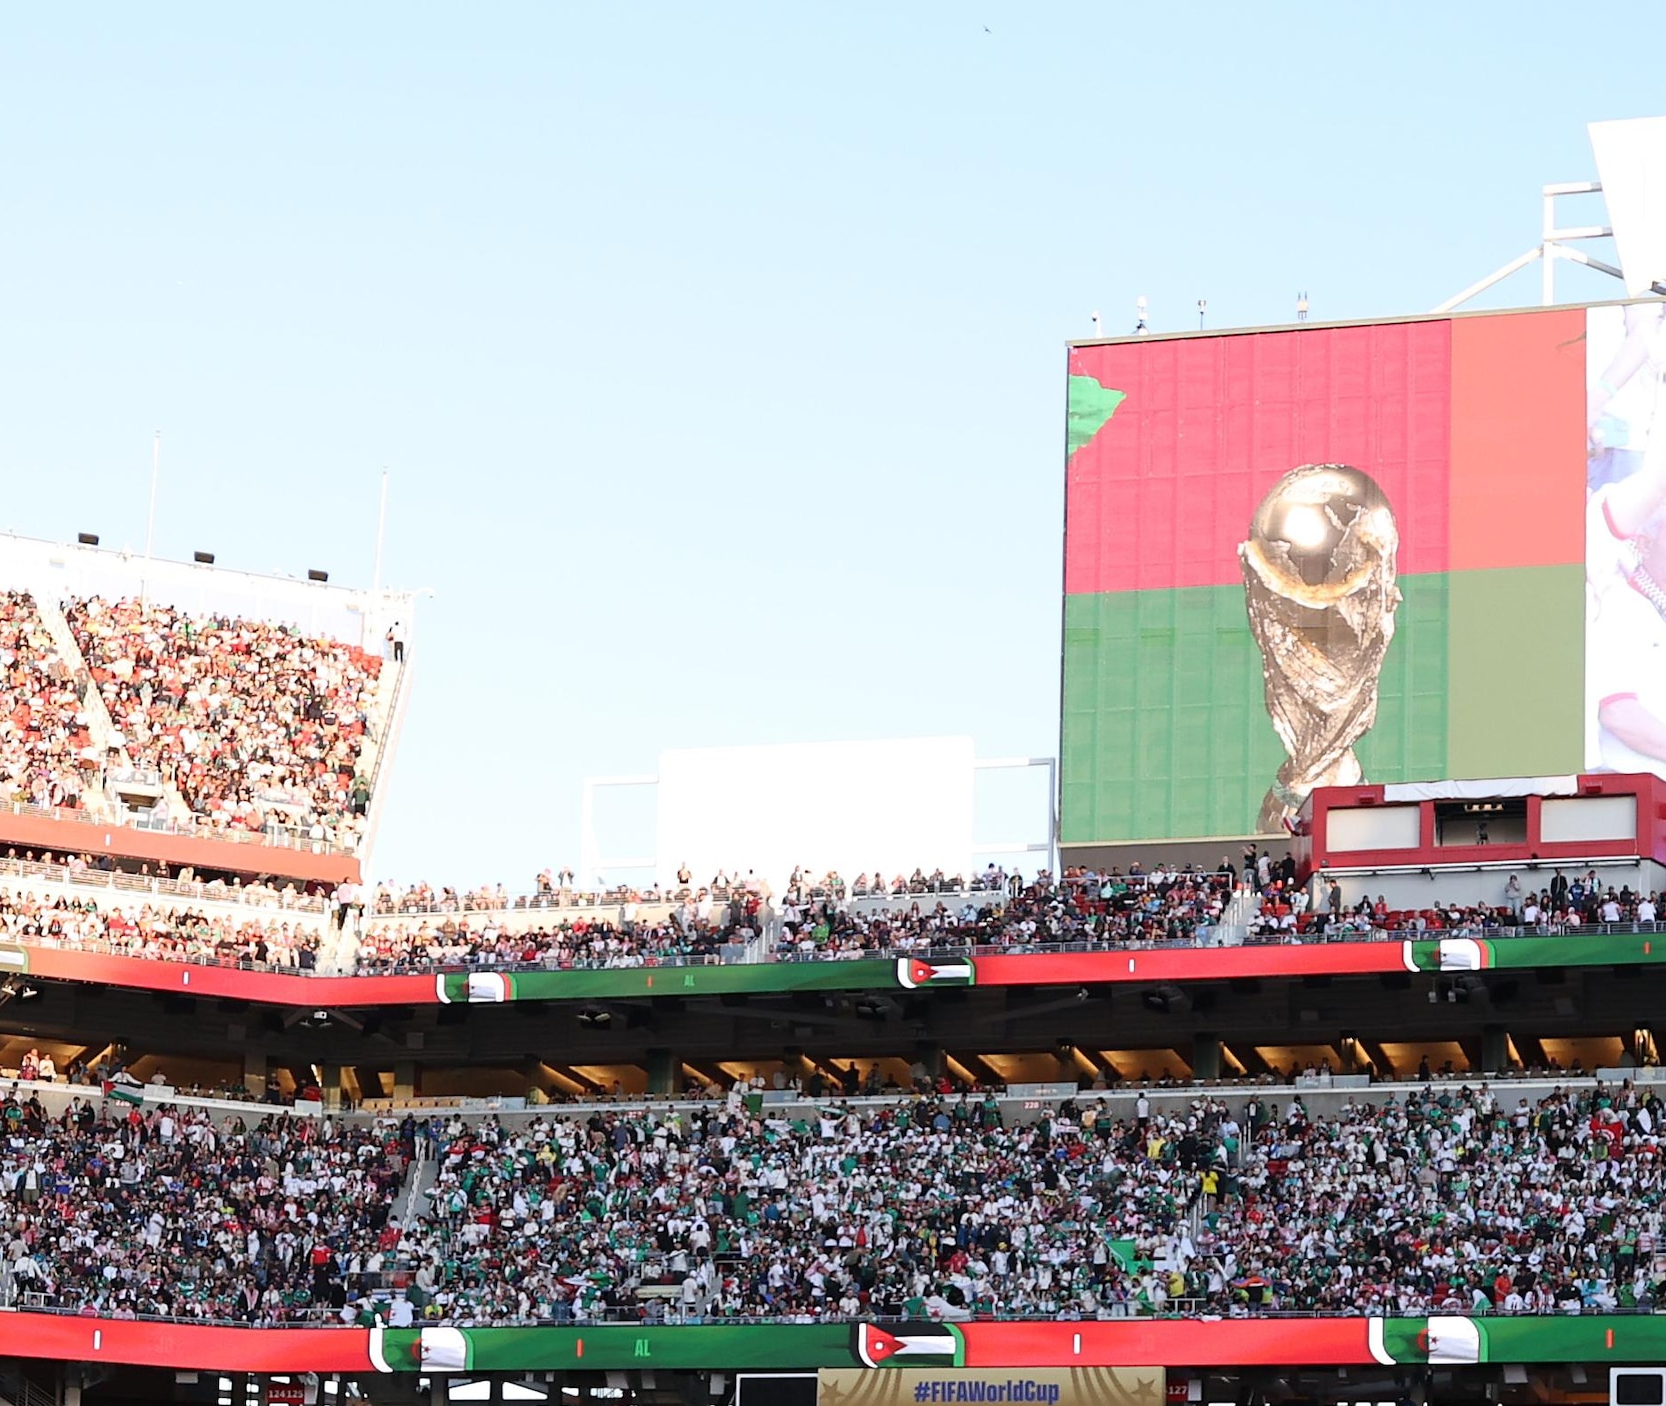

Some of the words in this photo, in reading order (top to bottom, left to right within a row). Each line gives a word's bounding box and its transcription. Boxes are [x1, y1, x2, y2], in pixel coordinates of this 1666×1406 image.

[635, 1339, 650, 1357] AL
[269, 1389, 285, 1398] 124
[287, 1389, 304, 1399] 125
[914, 1380, 1060, 1405] #FIFAWorldCup
[1169, 1385, 1187, 1396] 127
